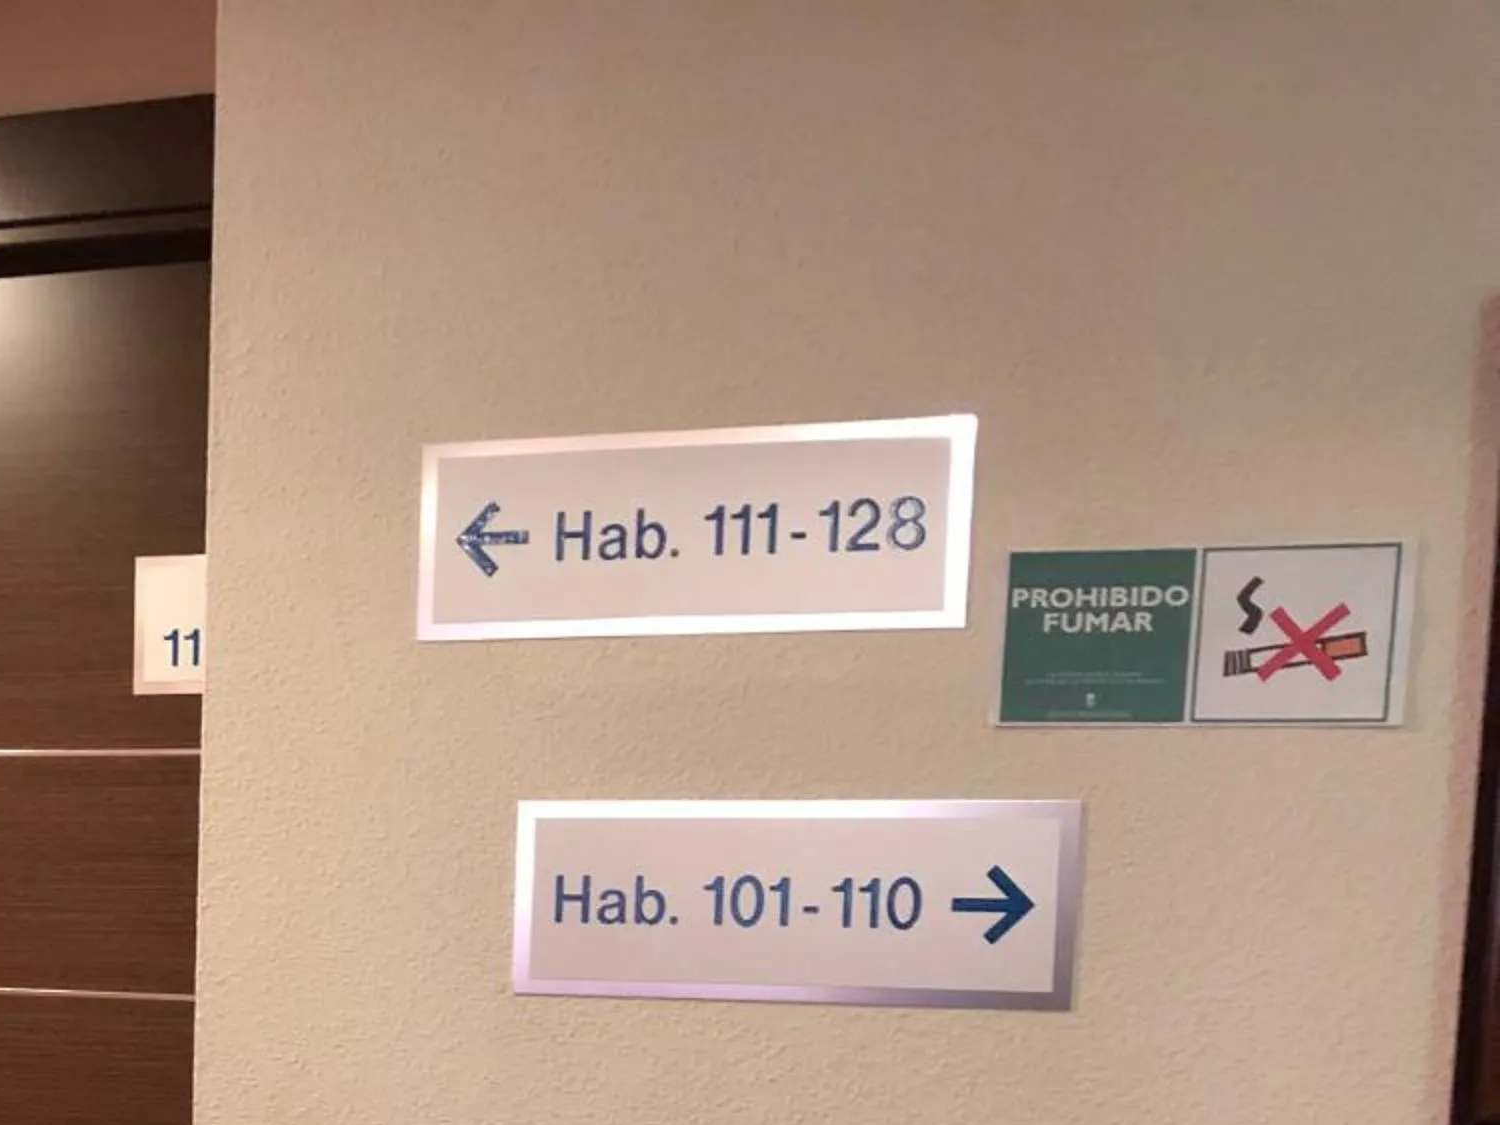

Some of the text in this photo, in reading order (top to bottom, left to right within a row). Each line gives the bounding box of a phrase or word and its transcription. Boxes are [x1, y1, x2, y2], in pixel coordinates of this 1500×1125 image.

[554, 495, 927, 561] Hab. 111-128
[1011, 586, 1190, 608] PROHIBIDO
[1043, 611, 1153, 633] FUMAR
[554, 874, 924, 930] Hab. 101-110
